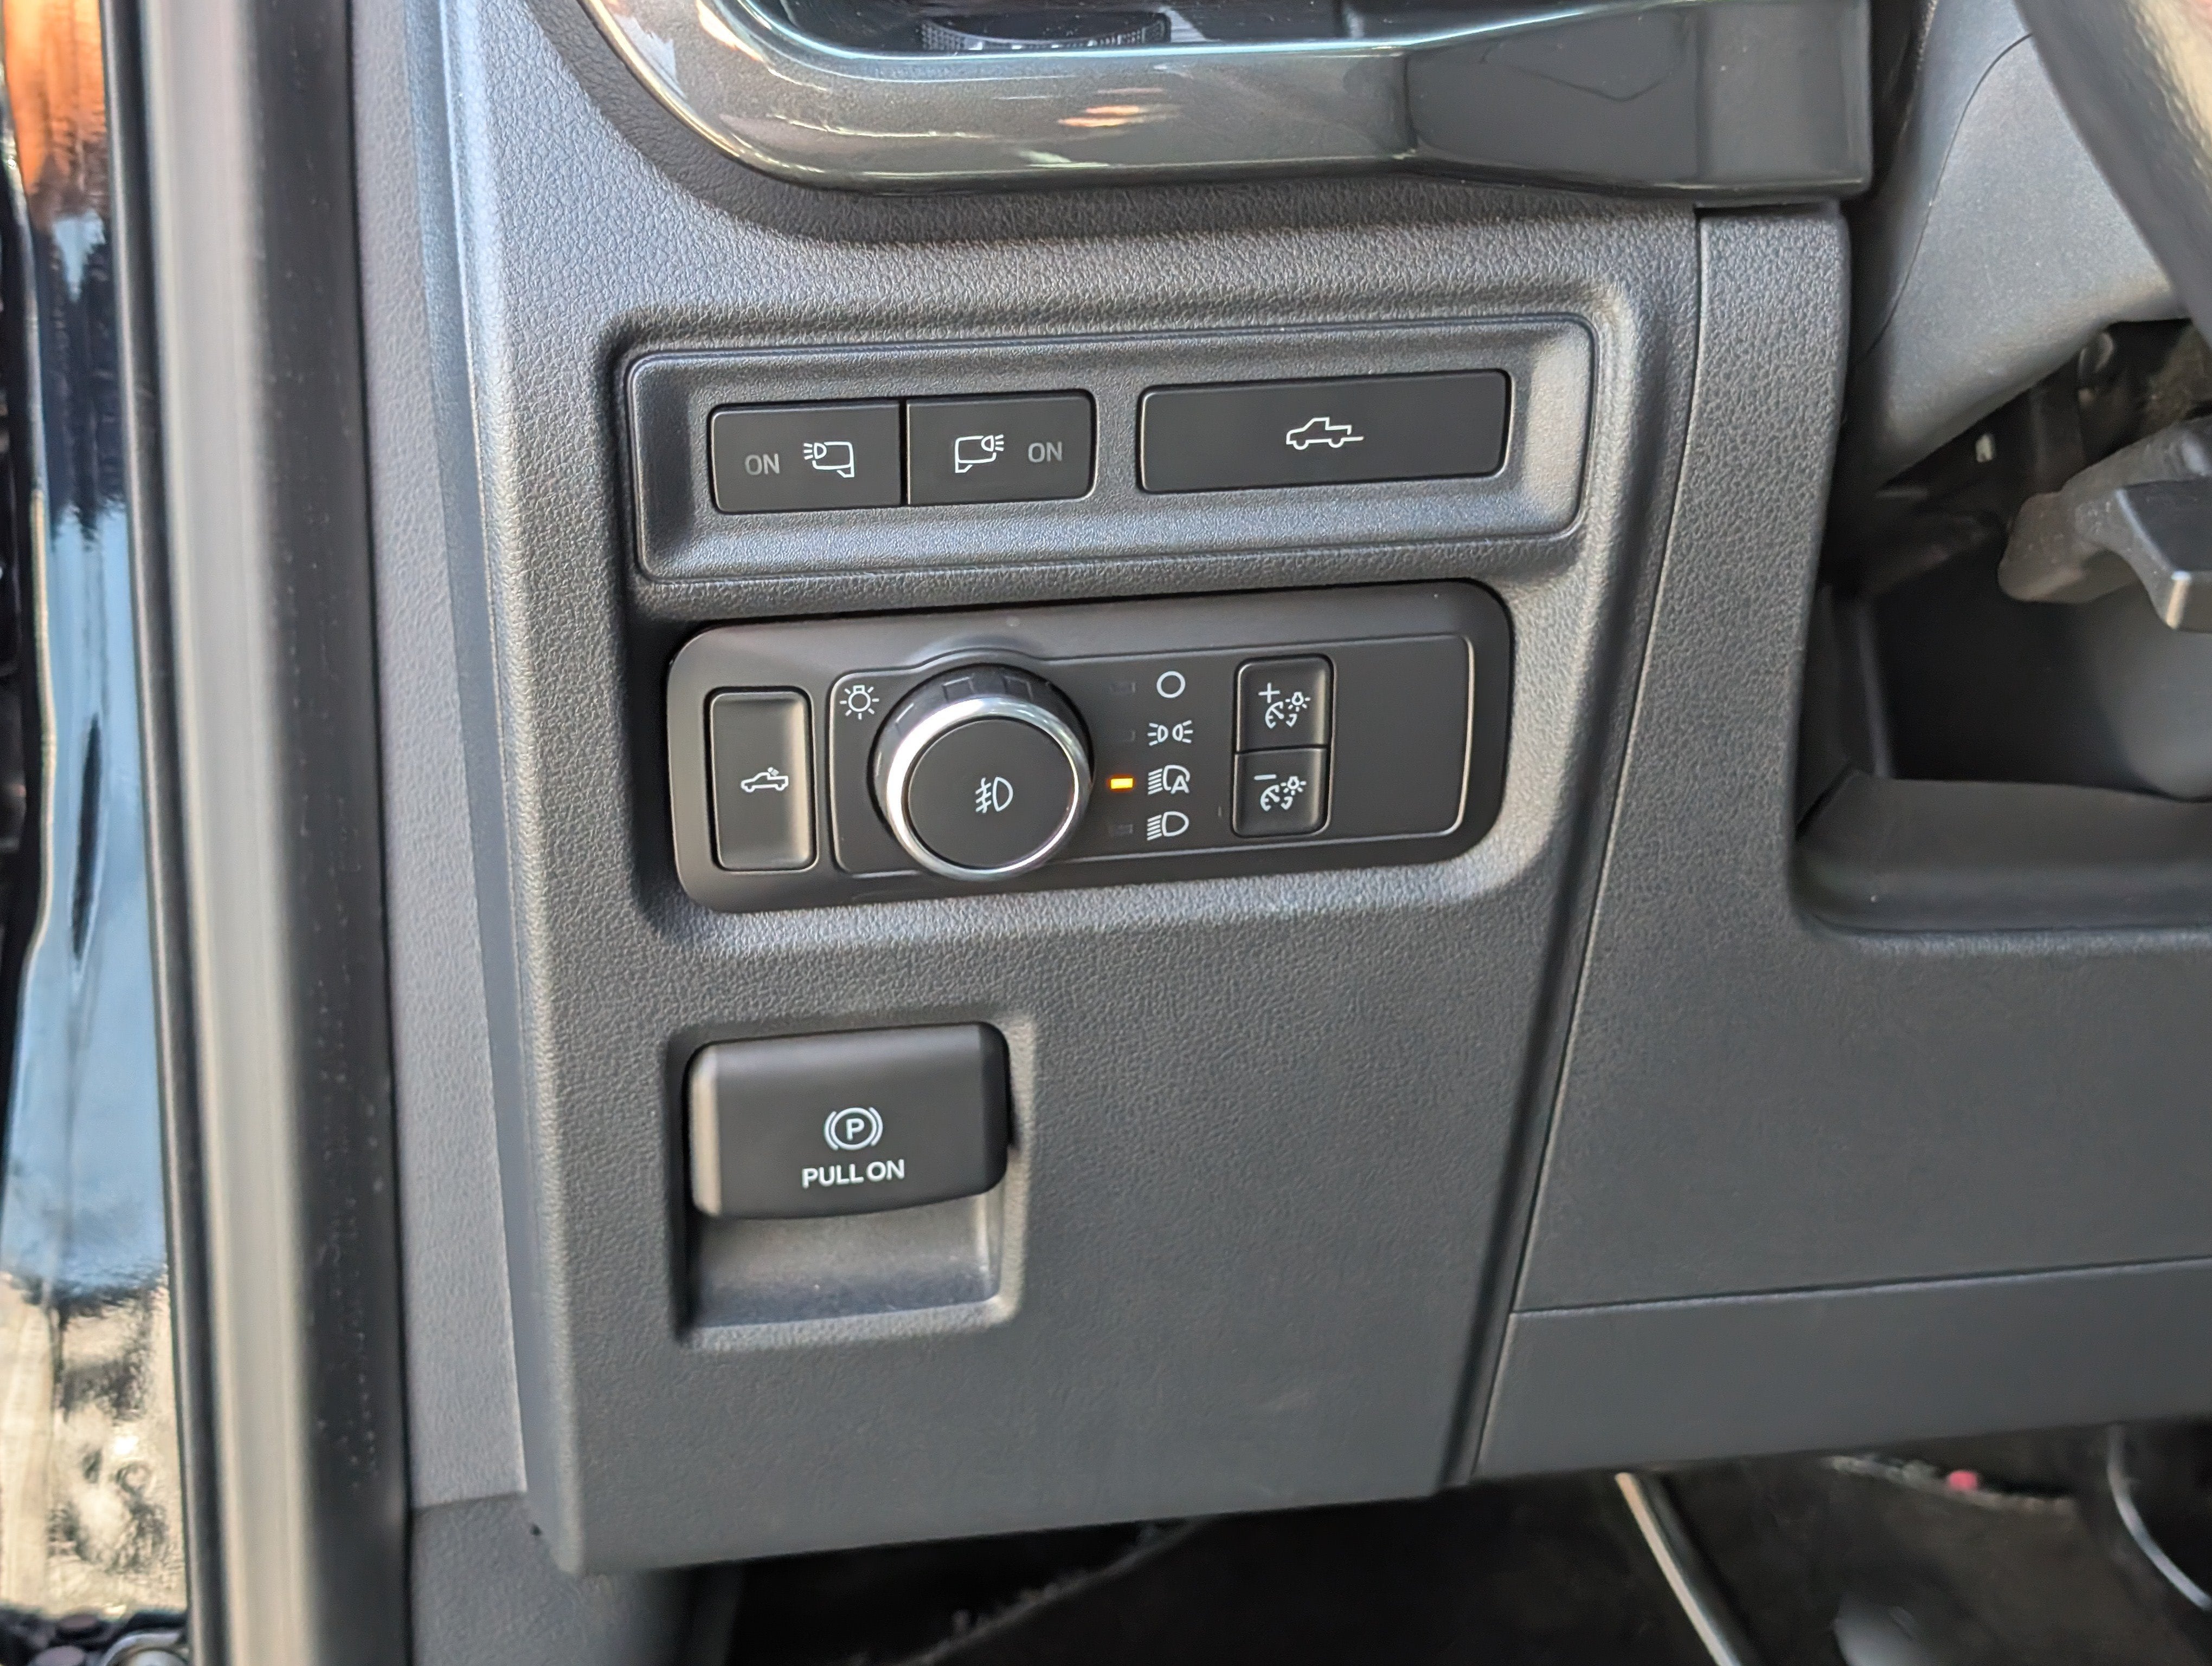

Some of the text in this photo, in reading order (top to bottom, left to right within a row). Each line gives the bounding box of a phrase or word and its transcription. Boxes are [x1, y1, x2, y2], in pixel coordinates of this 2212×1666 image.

[1028, 441, 1062, 463] ON
[745, 453, 780, 475] ON
[845, 1118, 865, 1141] P
[801, 1158, 905, 1189] PULL ON
